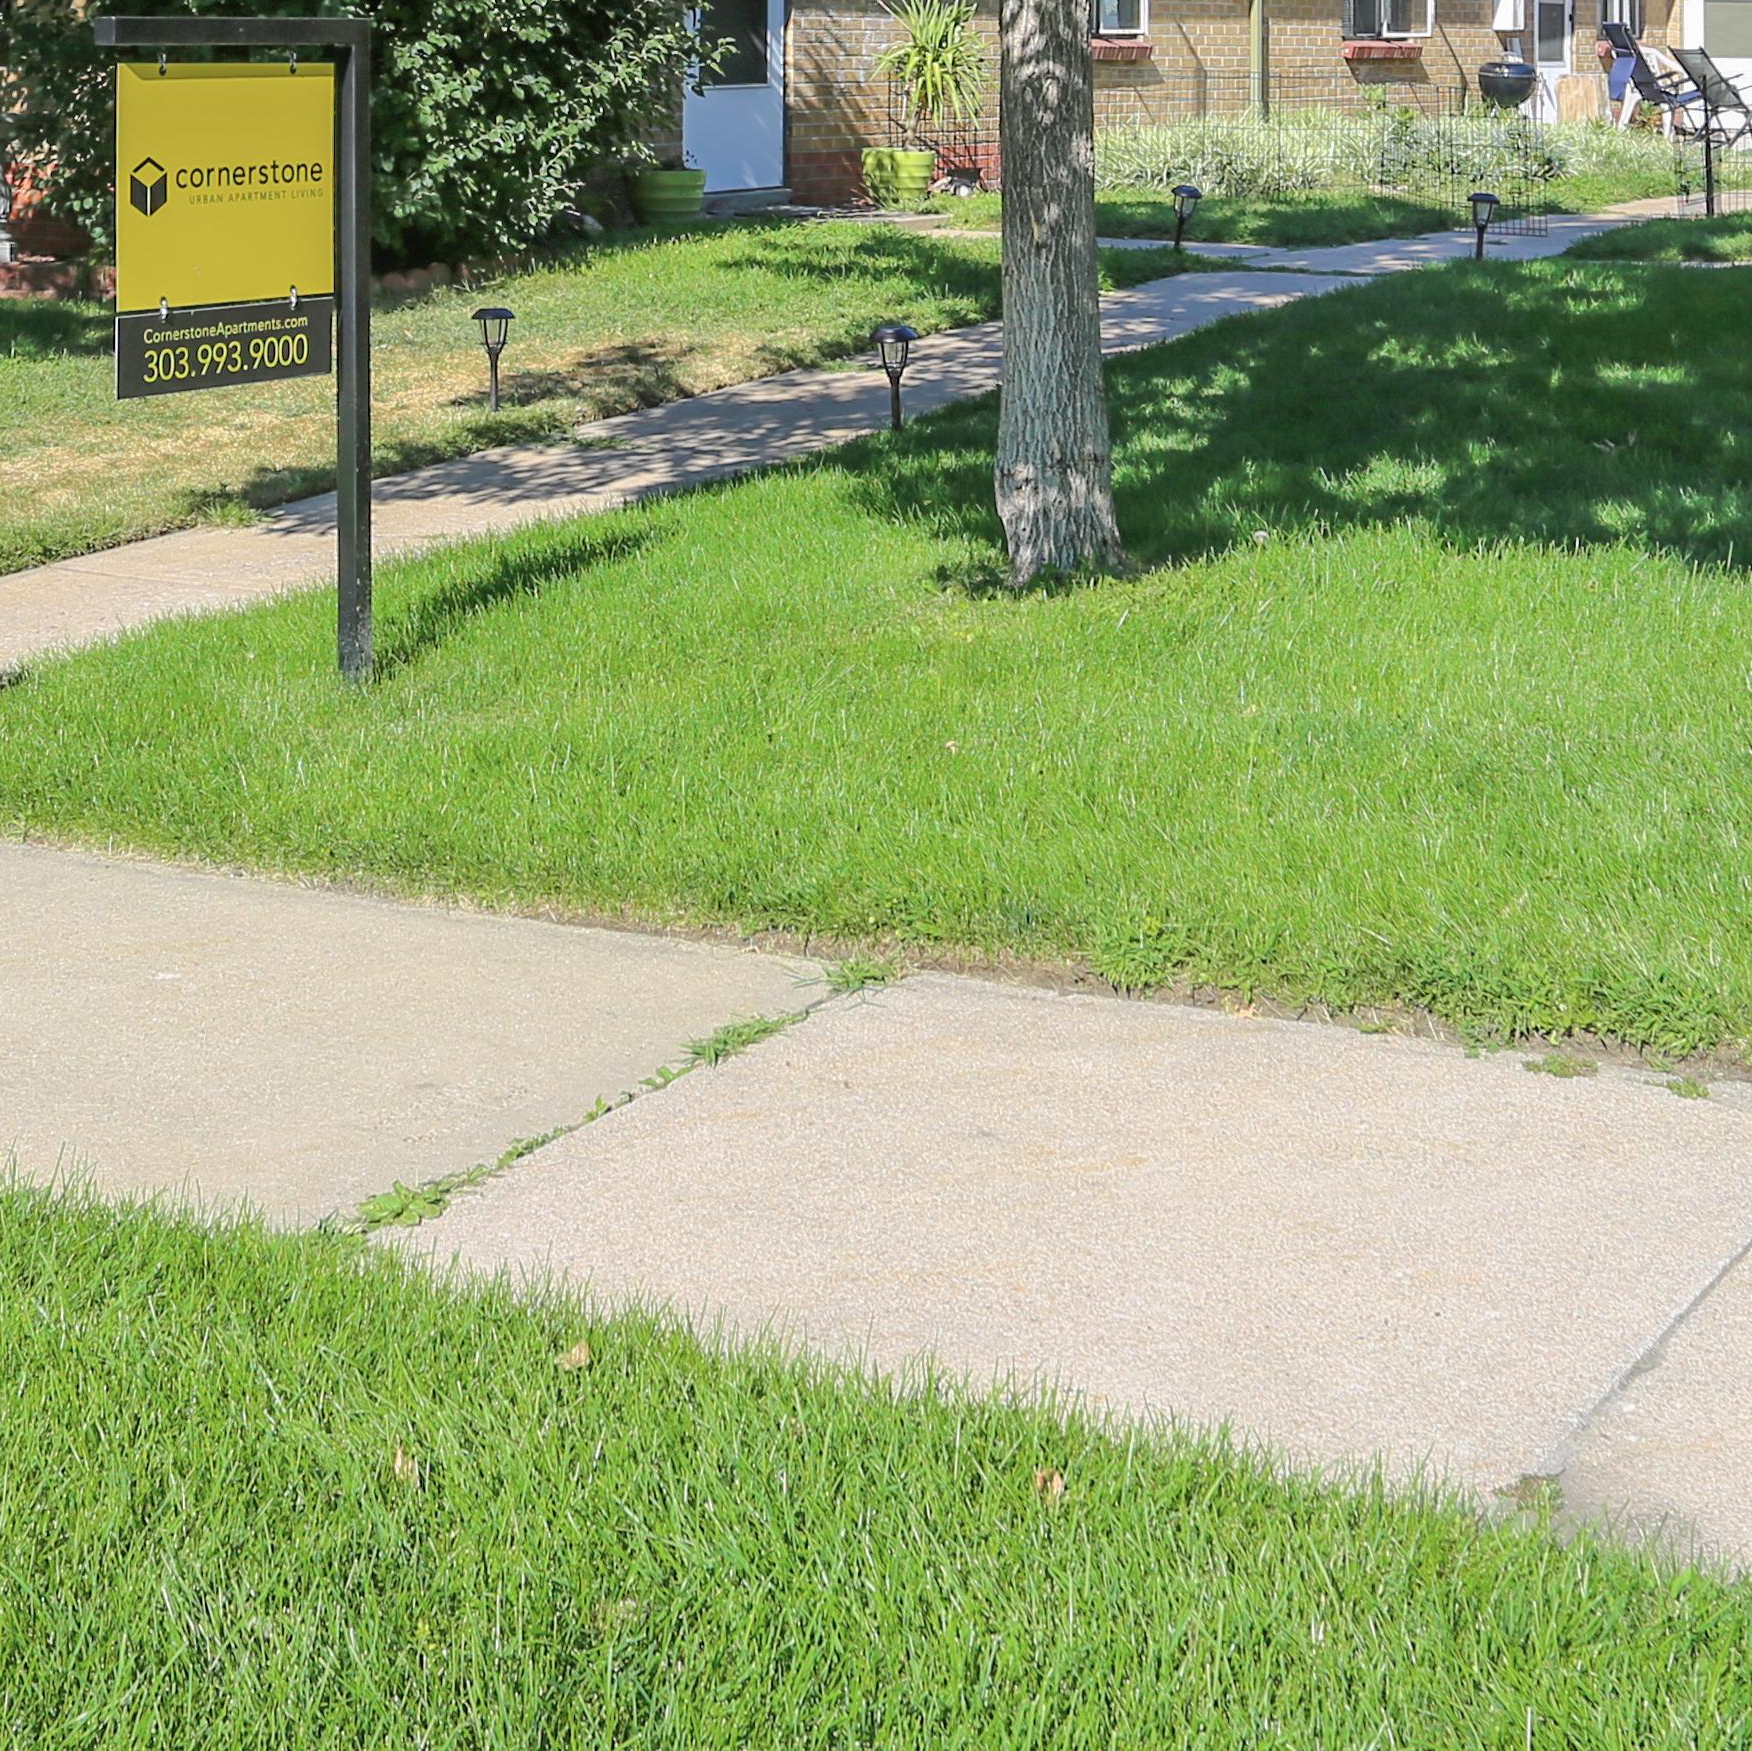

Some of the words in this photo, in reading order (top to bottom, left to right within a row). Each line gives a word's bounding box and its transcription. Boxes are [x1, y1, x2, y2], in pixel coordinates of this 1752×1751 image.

[175, 160, 323, 189] cornerstone
[188, 194, 223, 205] URBAN
[227, 190, 286, 203] APARTMENT
[291, 188, 323, 199] LIVING
[143, 315, 308, 344] CornerstoneApartments.com
[143, 333, 308, 383] 303.993.9000
